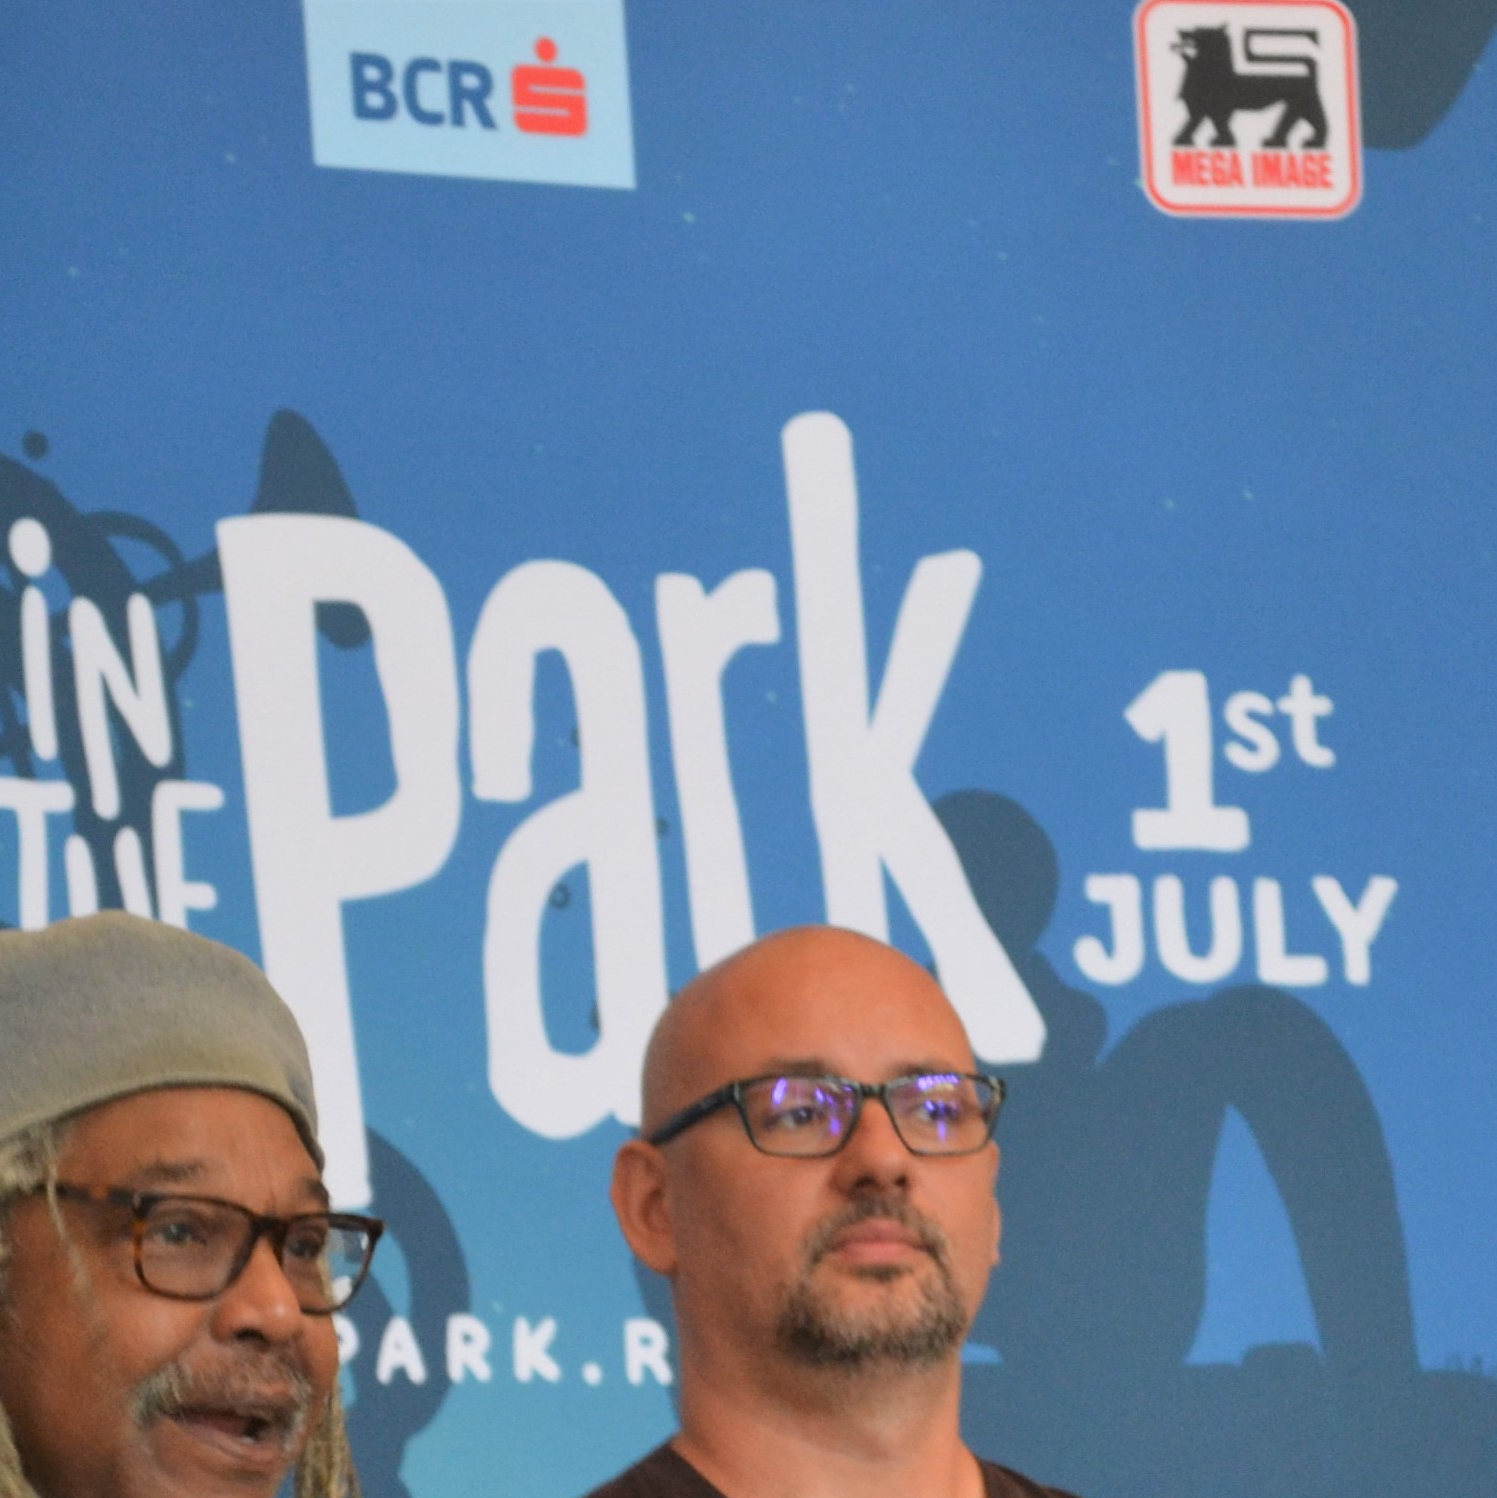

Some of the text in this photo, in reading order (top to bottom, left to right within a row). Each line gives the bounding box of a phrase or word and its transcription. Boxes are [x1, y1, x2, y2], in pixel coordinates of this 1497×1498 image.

[349, 52, 498, 131] BCR
[1170, 149, 1333, 190] MEGA IMAGE
[215, 411, 1046, 1210] Park
[1122, 669, 1337, 853] 1st
[1073, 873, 1399, 987] JULY
